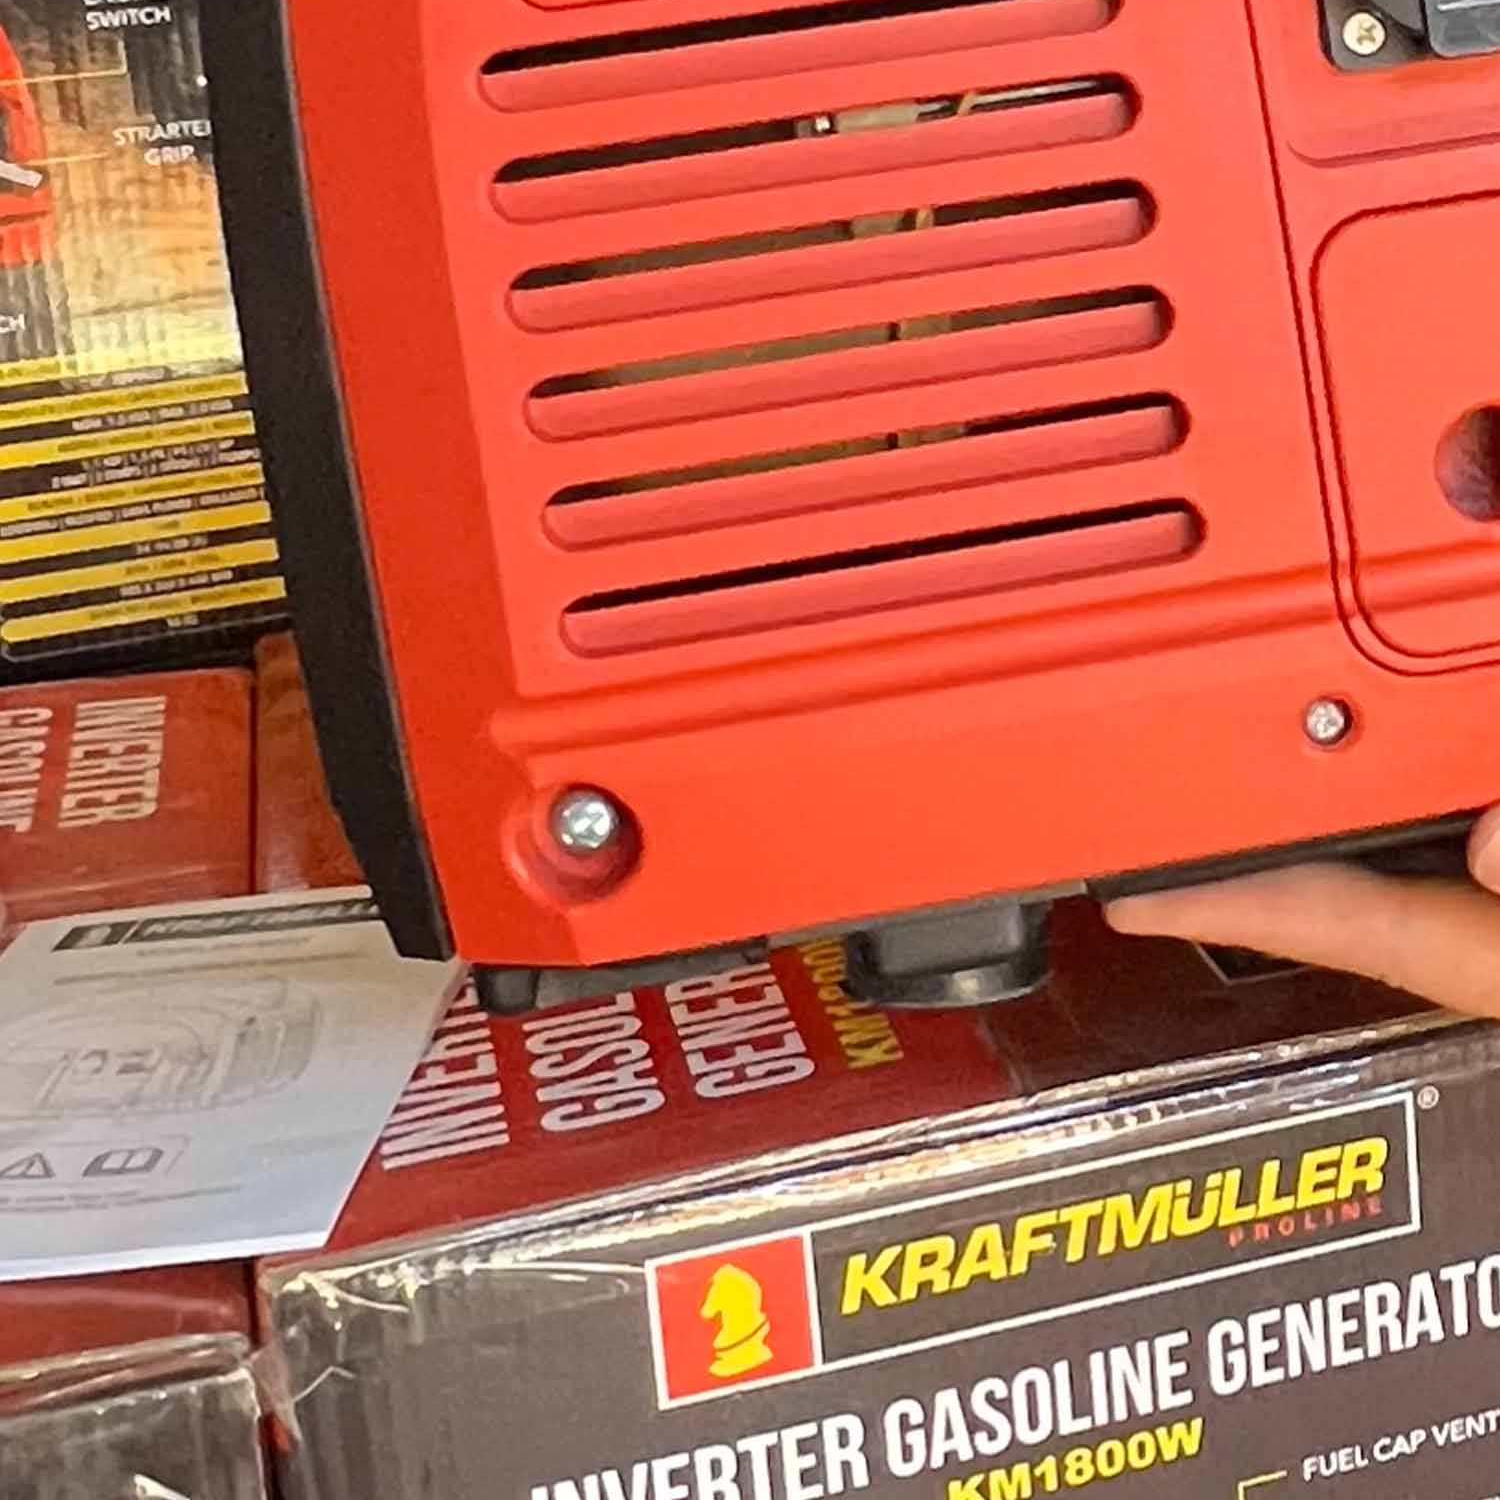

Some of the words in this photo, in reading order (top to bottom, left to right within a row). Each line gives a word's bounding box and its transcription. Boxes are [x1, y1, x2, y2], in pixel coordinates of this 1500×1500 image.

[86, 5, 171, 31] SWITCH
[57, 694, 167, 829] INVERTER
[840, 1135, 1390, 1315] KRAFTMÜLLER
[1227, 1198, 1386, 1249] PROLINE
[531, 1413, 868, 1500] ERTER
[884, 1330, 1194, 1477] GASOLINE
[1302, 1445, 1369, 1482] FUEL
[1373, 1428, 1427, 1462] CAP
[947, 1417, 1204, 1500] KM1800W
